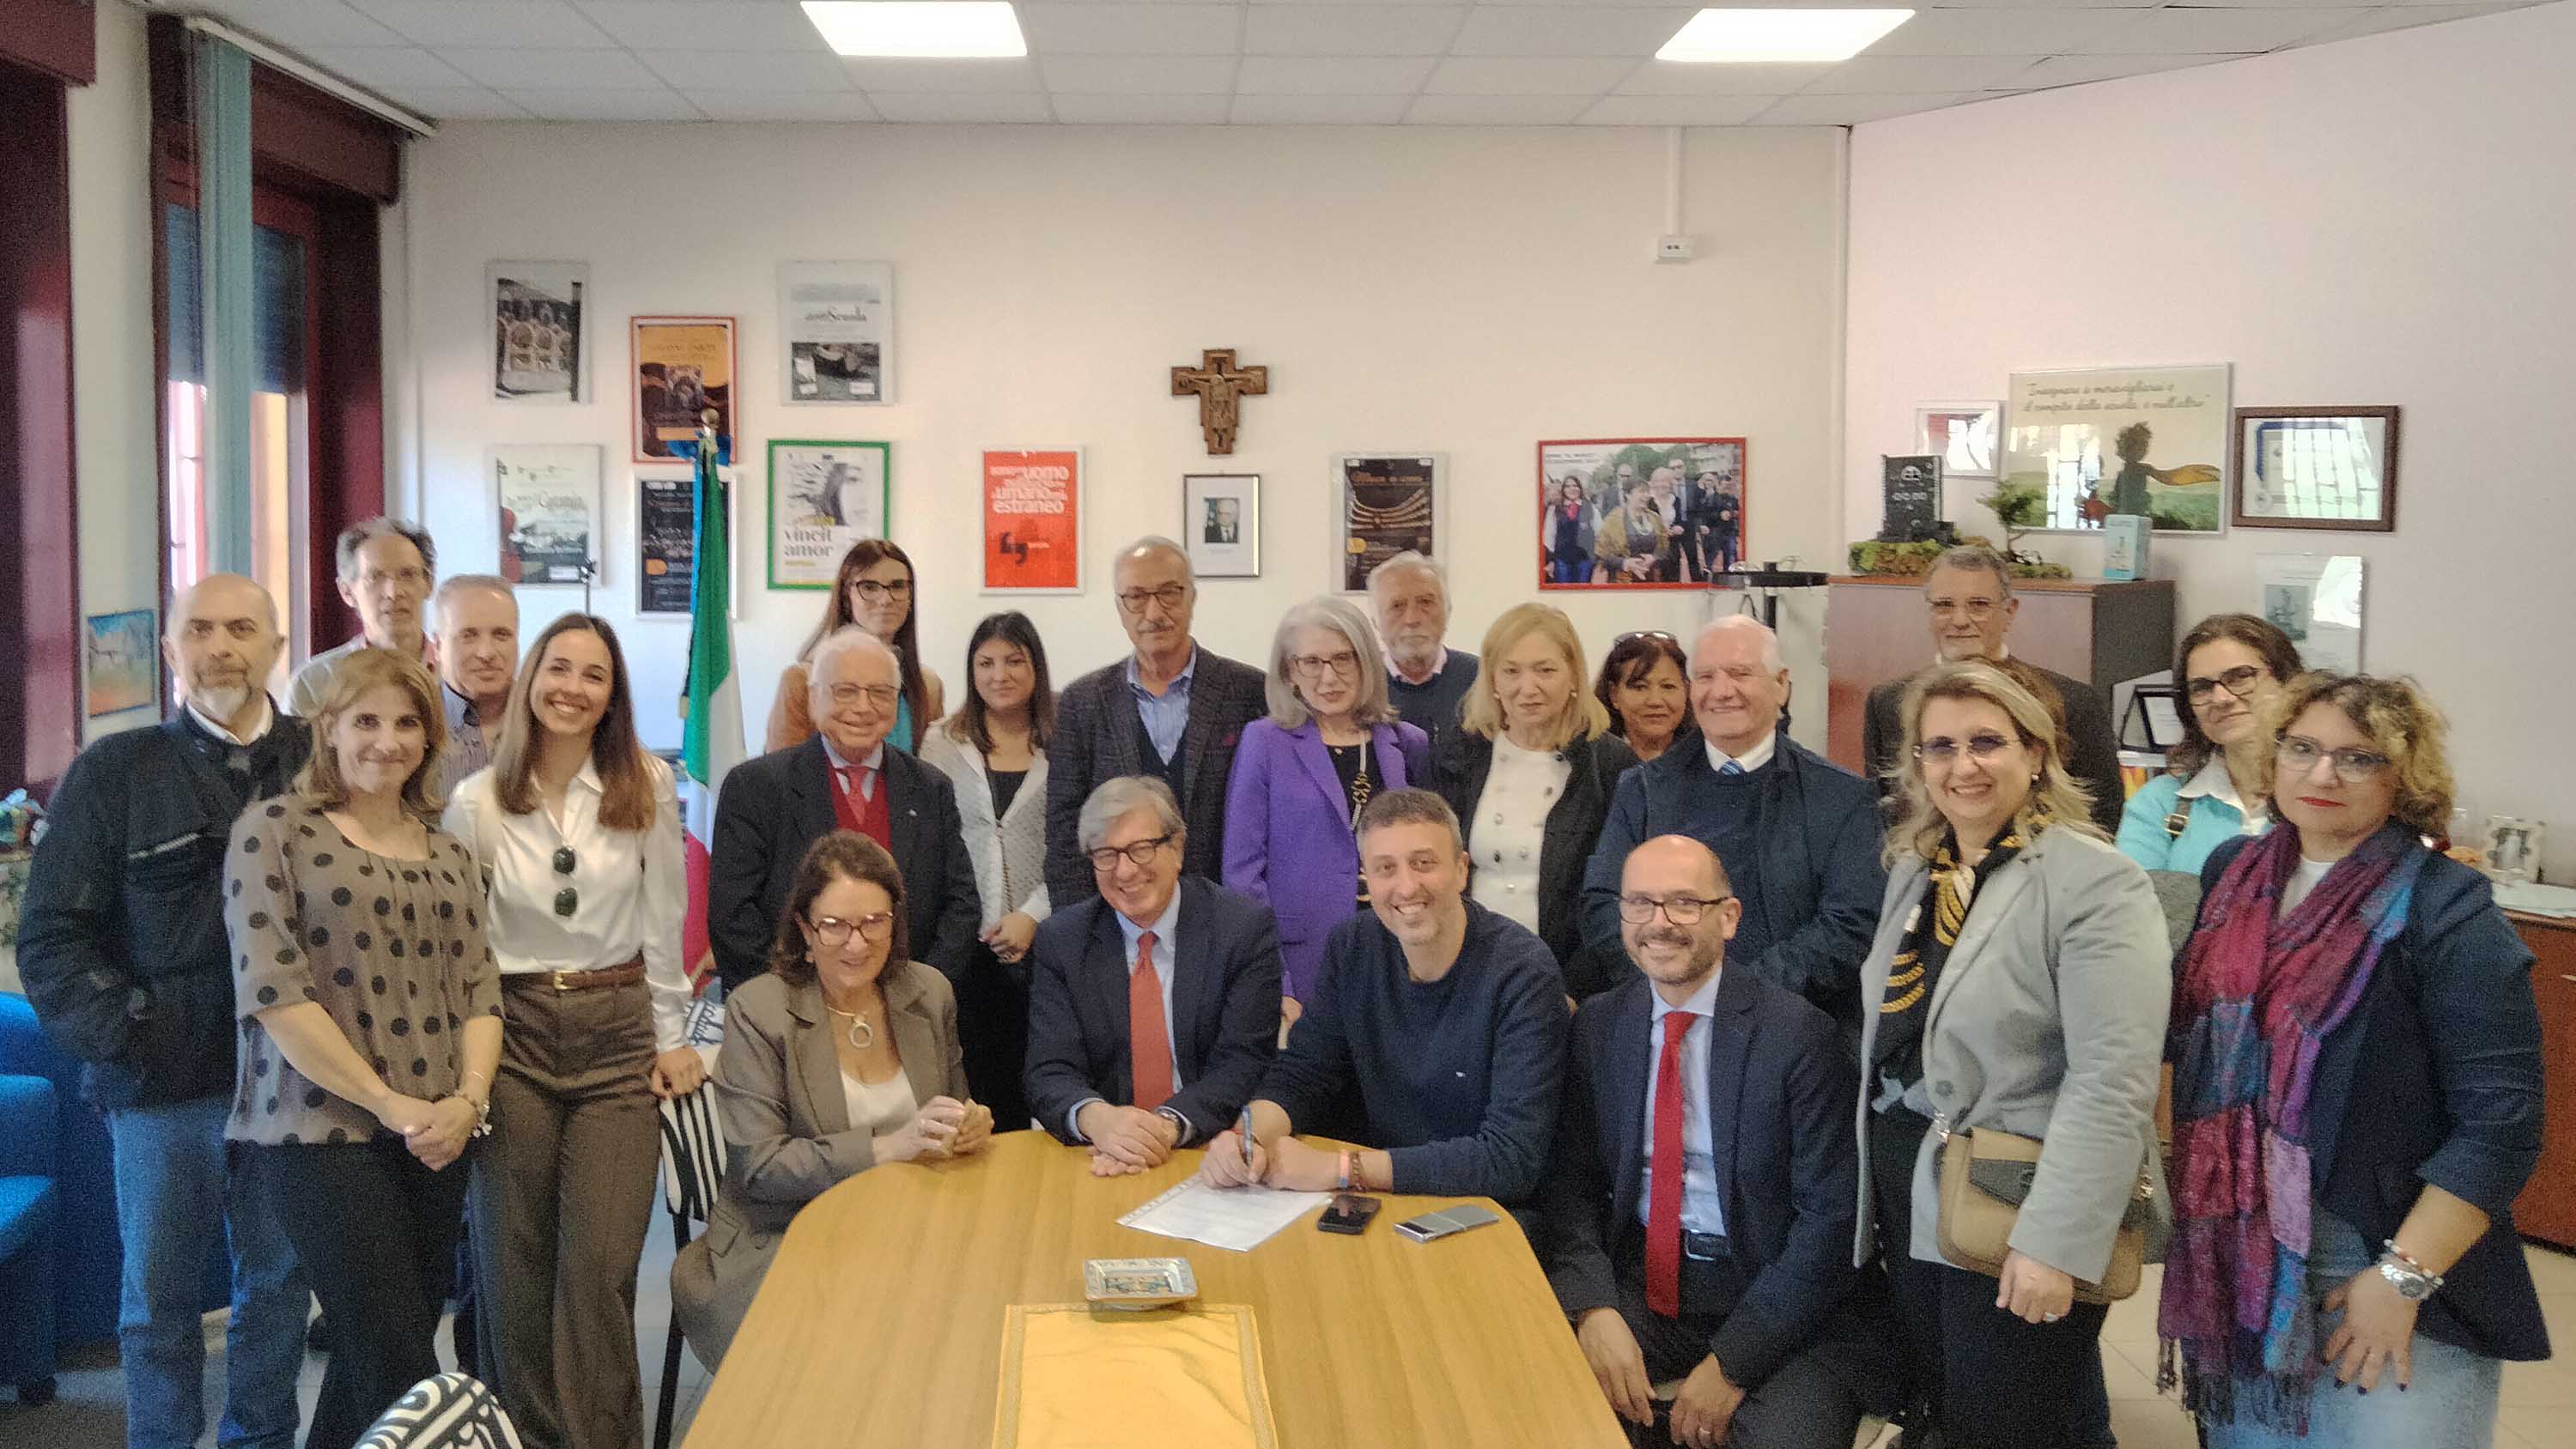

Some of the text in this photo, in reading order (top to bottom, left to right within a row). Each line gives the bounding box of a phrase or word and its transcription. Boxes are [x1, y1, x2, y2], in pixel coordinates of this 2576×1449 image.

[1022, 466, 1070, 481] uomo
[993, 500, 1065, 514] estraneo
[783, 527, 833, 543] vincit
[783, 544, 834, 557] amor
